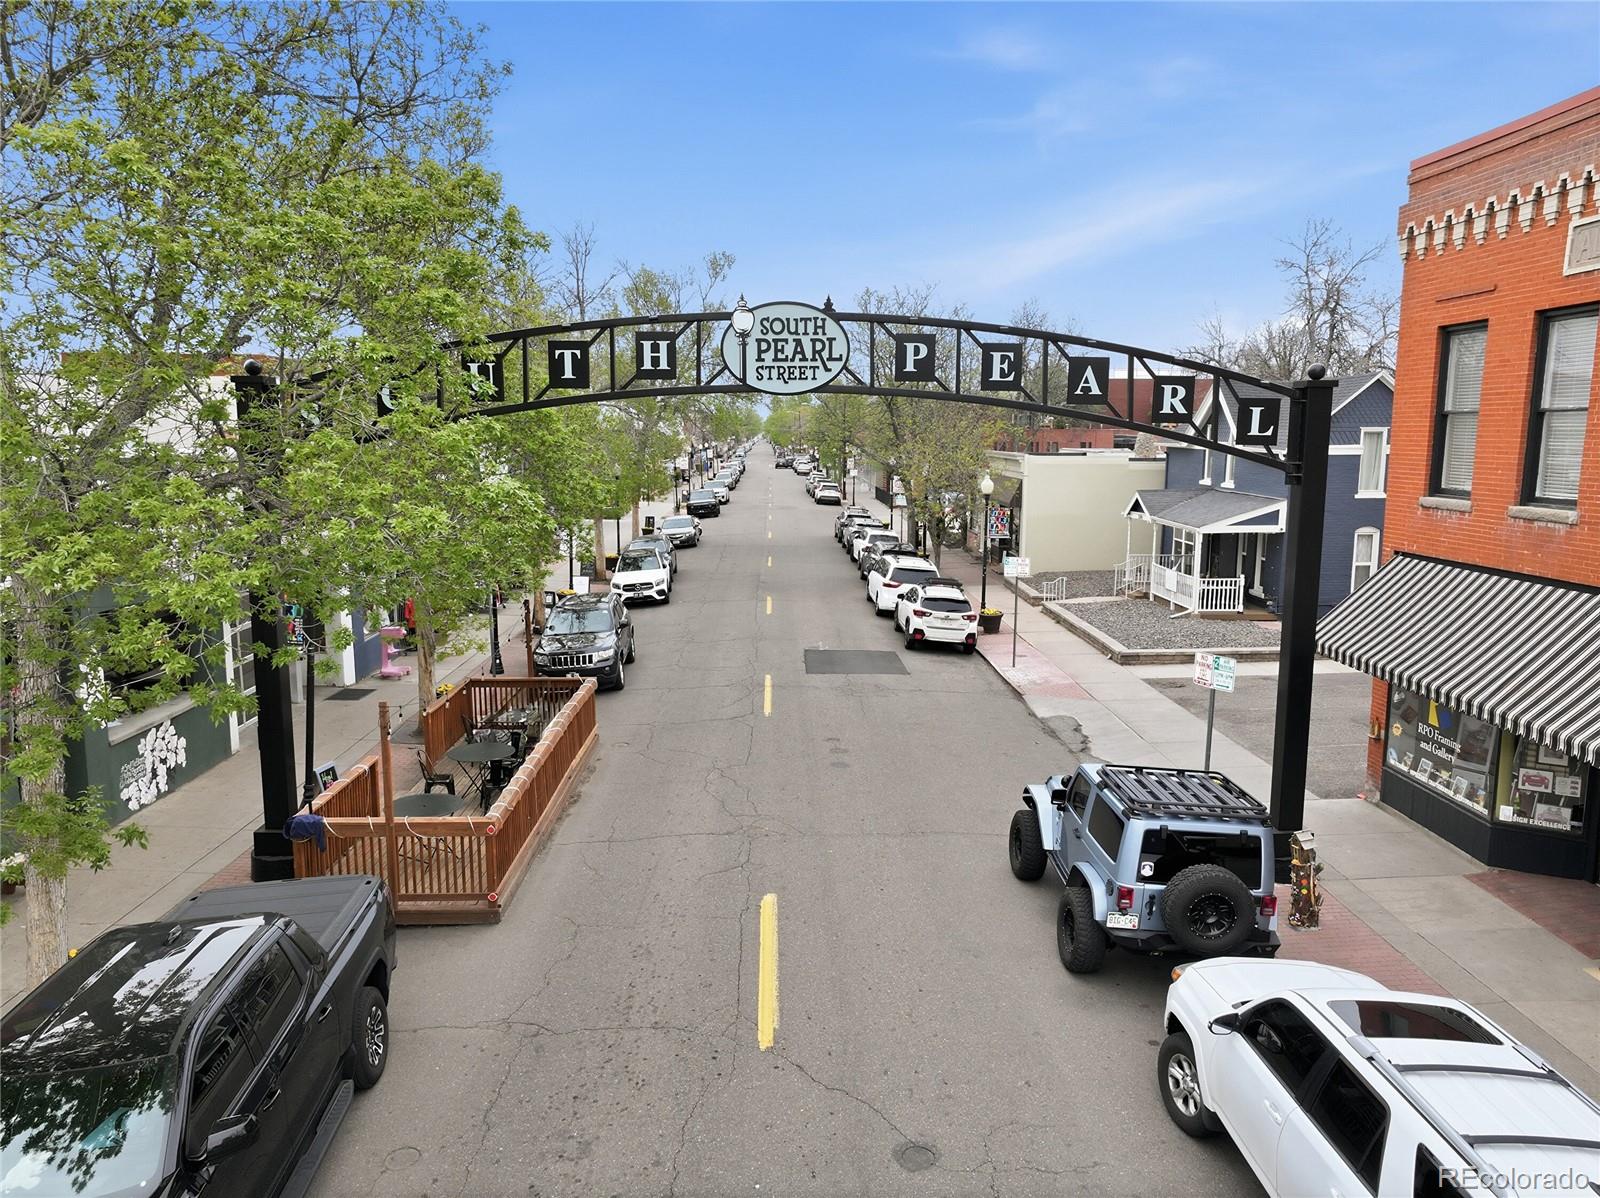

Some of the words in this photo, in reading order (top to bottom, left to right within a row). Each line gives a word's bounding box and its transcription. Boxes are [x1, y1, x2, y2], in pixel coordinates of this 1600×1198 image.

[760, 316, 828, 336] SOUTH
[755, 337, 843, 372] PEARL
[755, 365, 820, 384] STREET
[1418, 722, 1434, 738] RPO
[1434, 730, 1461, 753] Framing
[1420, 741, 1432, 752] and
[1432, 744, 1455, 764] Gallery
[1529, 818, 1571, 831] EXCELLENCE
